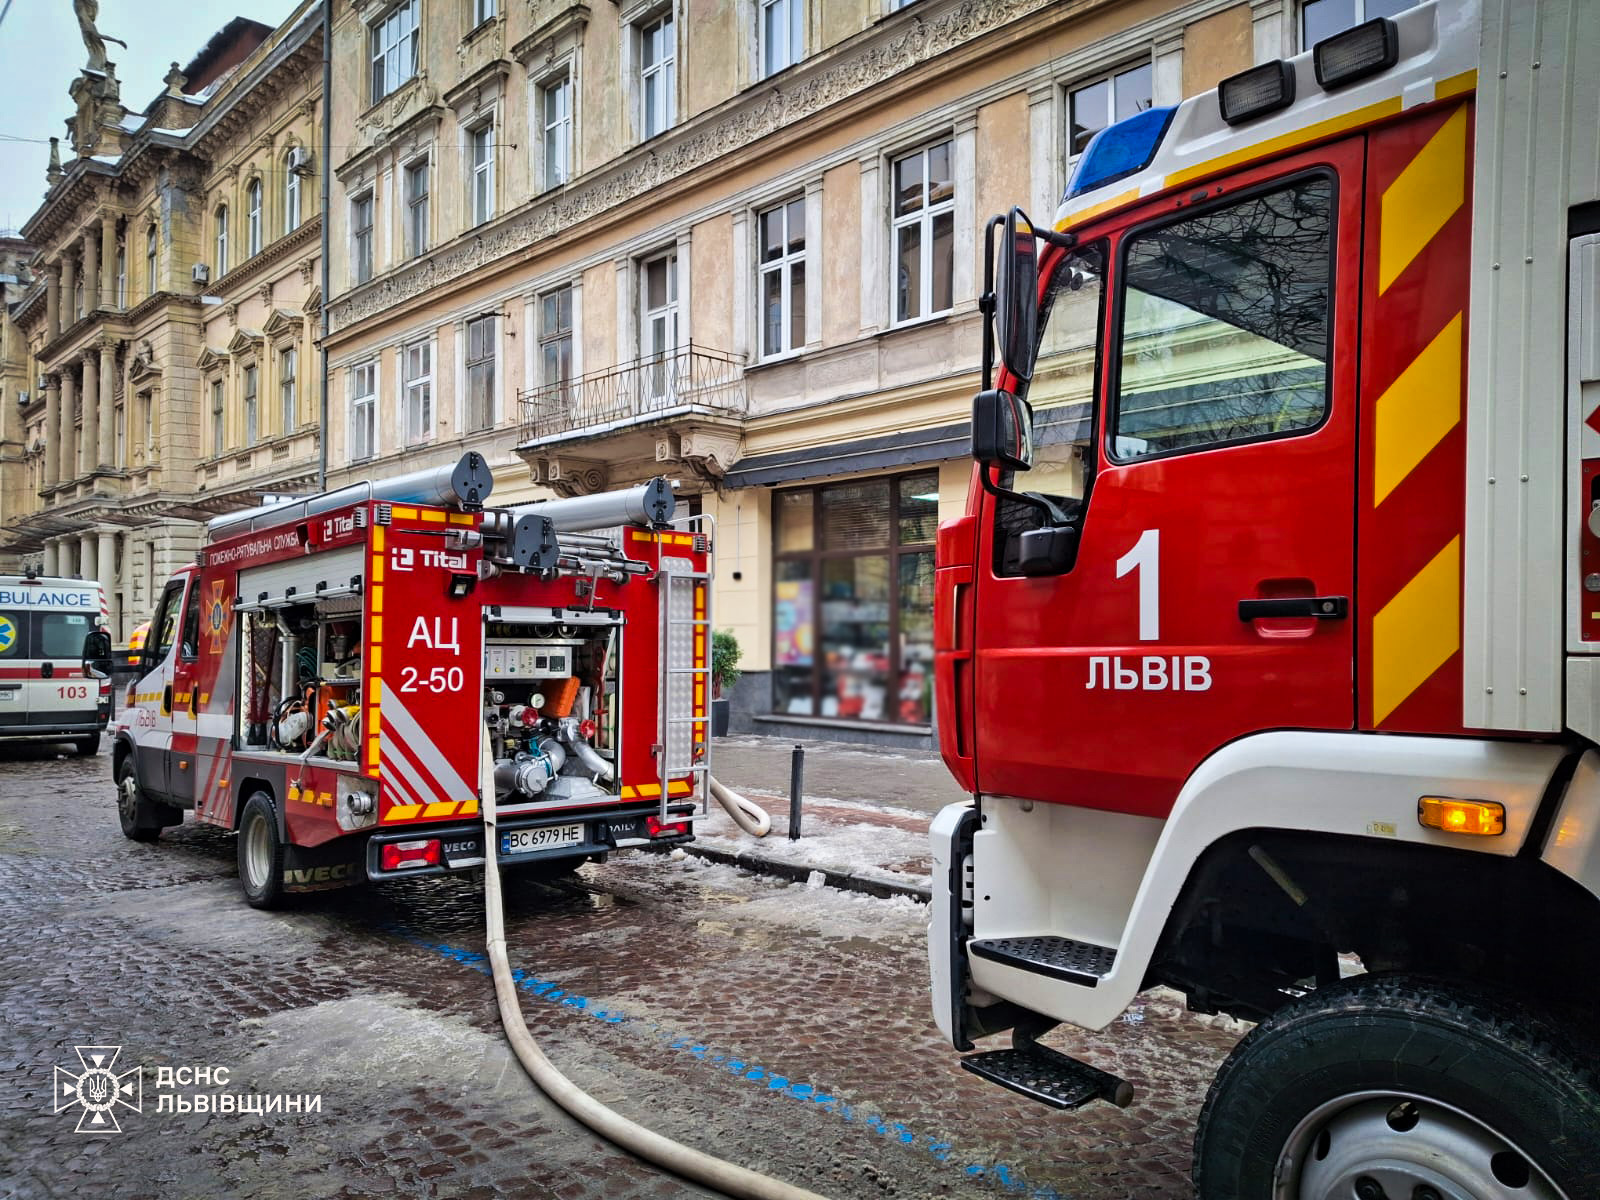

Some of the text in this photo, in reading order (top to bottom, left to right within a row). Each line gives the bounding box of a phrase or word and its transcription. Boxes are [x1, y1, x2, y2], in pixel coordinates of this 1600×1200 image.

[335, 515, 354, 534] Tital
[210, 532, 300, 567] ПОЖЕЖНО-РЯТУВАЛЬНА СЛУЖБА
[420, 549, 467, 569] Tital
[1116, 528, 1160, 641] 1
[407, 616, 460, 656] АЦ
[400, 666, 464, 693] 2-50
[1085, 655, 1213, 691] ЛЬВІВ
[57, 686, 88, 700] 103
[443, 840, 477, 853] VECO
[510, 826, 579, 848] BC 6979 HE
